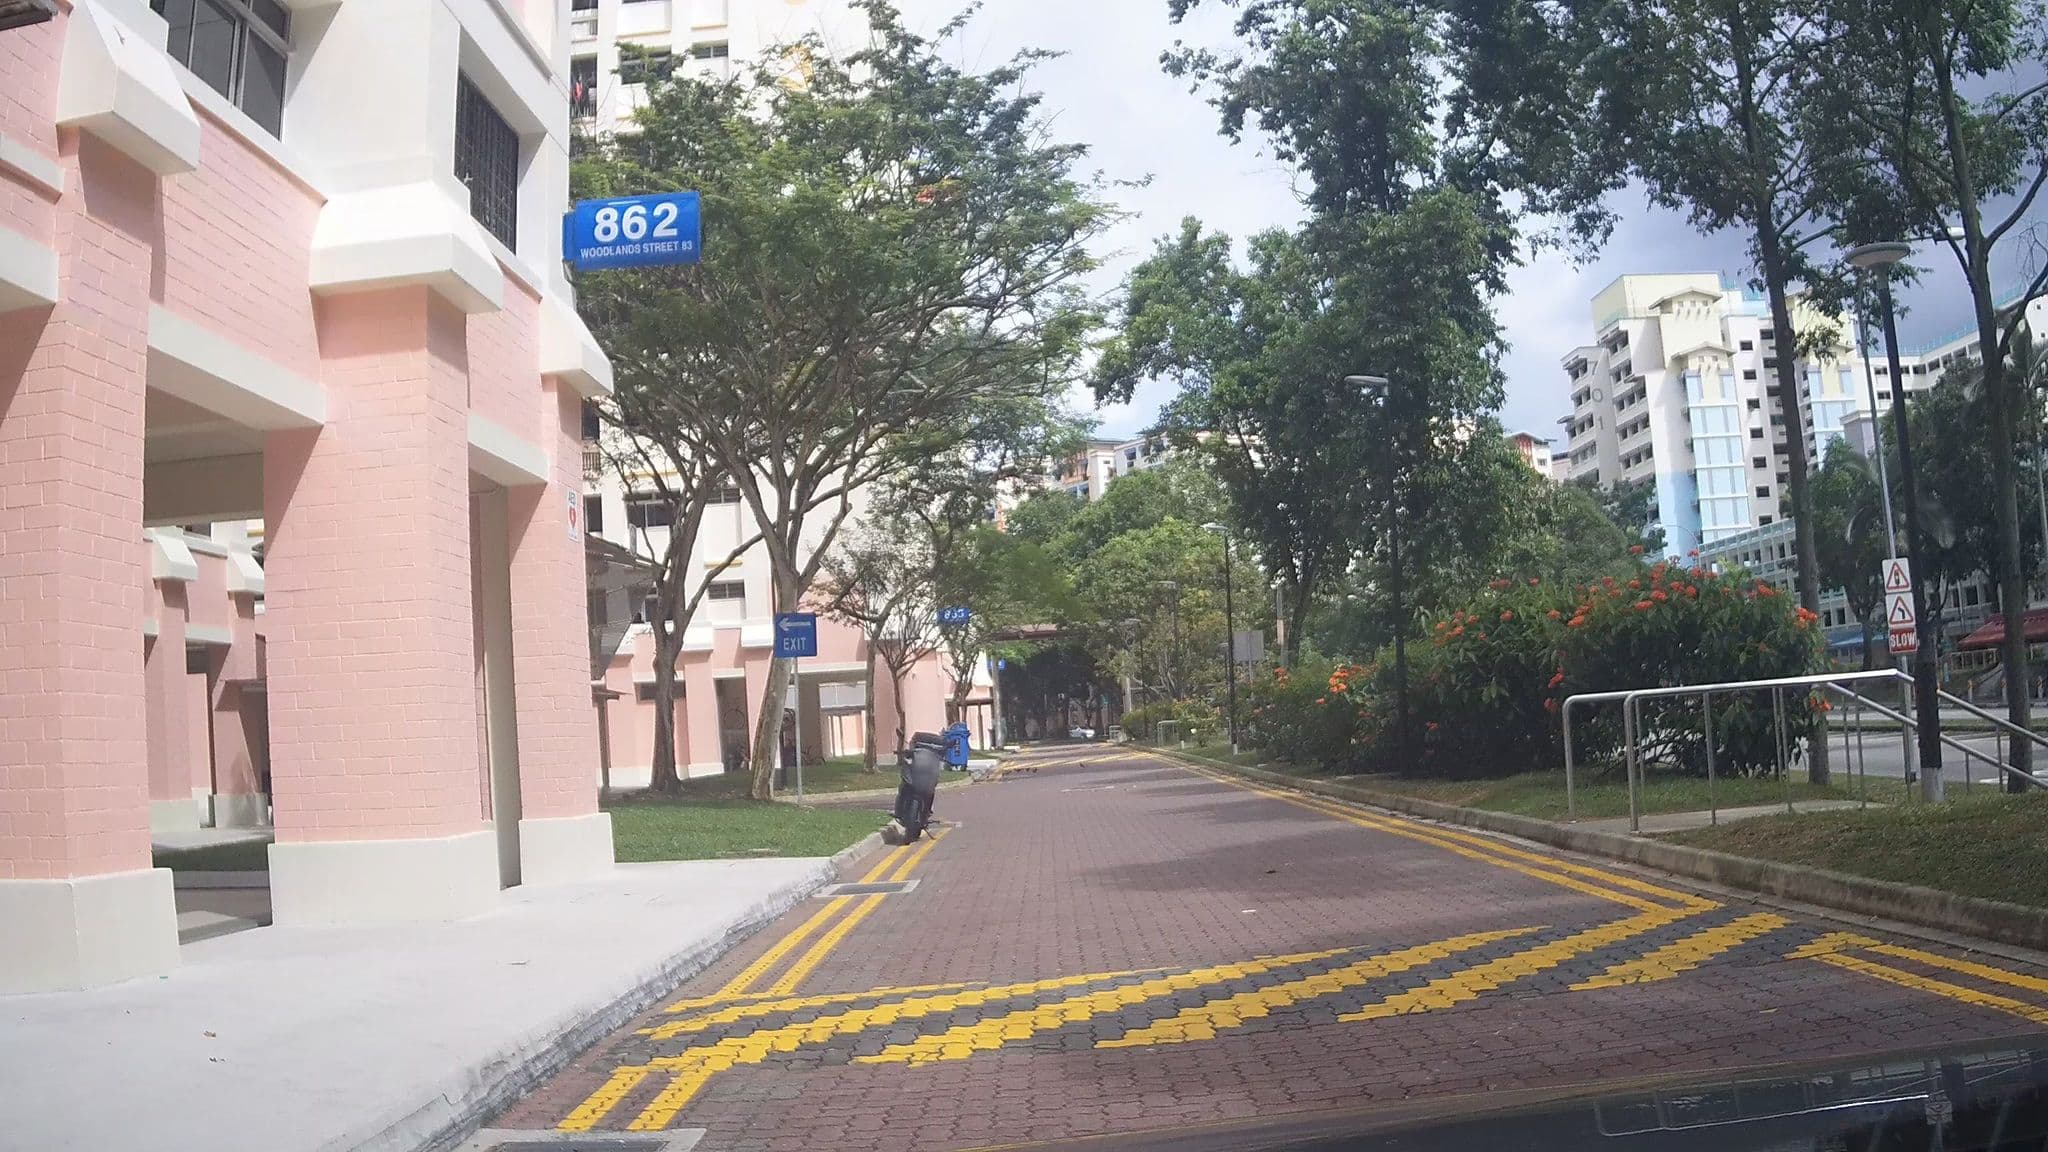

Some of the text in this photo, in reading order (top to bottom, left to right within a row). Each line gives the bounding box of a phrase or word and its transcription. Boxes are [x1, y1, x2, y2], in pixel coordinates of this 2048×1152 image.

[594, 202, 678, 242] 862
[580, 240, 693, 259] WOODLANDS STREET 83
[783, 637, 807, 651] EXIT
[1890, 631, 1917, 648] SLOW
